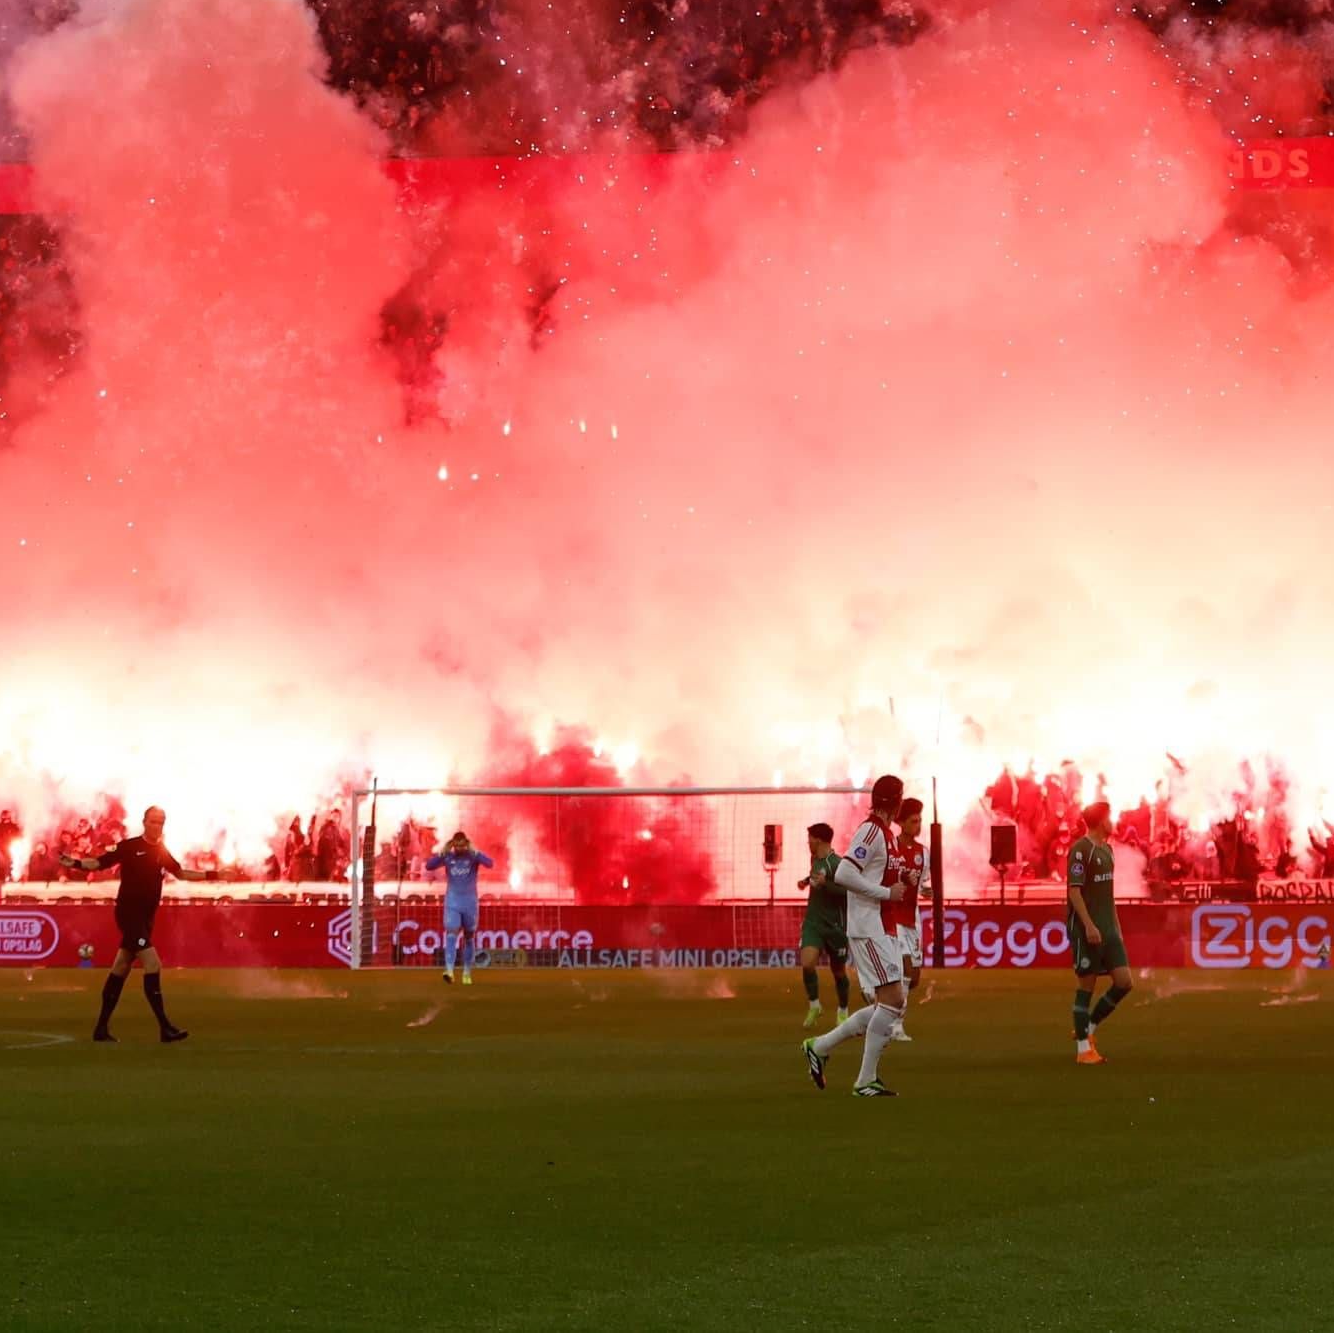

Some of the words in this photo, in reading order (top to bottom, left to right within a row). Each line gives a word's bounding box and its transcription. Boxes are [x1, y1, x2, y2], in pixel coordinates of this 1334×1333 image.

[3, 938, 42, 952] OPSLAG
[558, 949, 653, 967] ALLSAFE
[659, 949, 706, 967] MINI
[712, 949, 796, 967] OPSLAG
